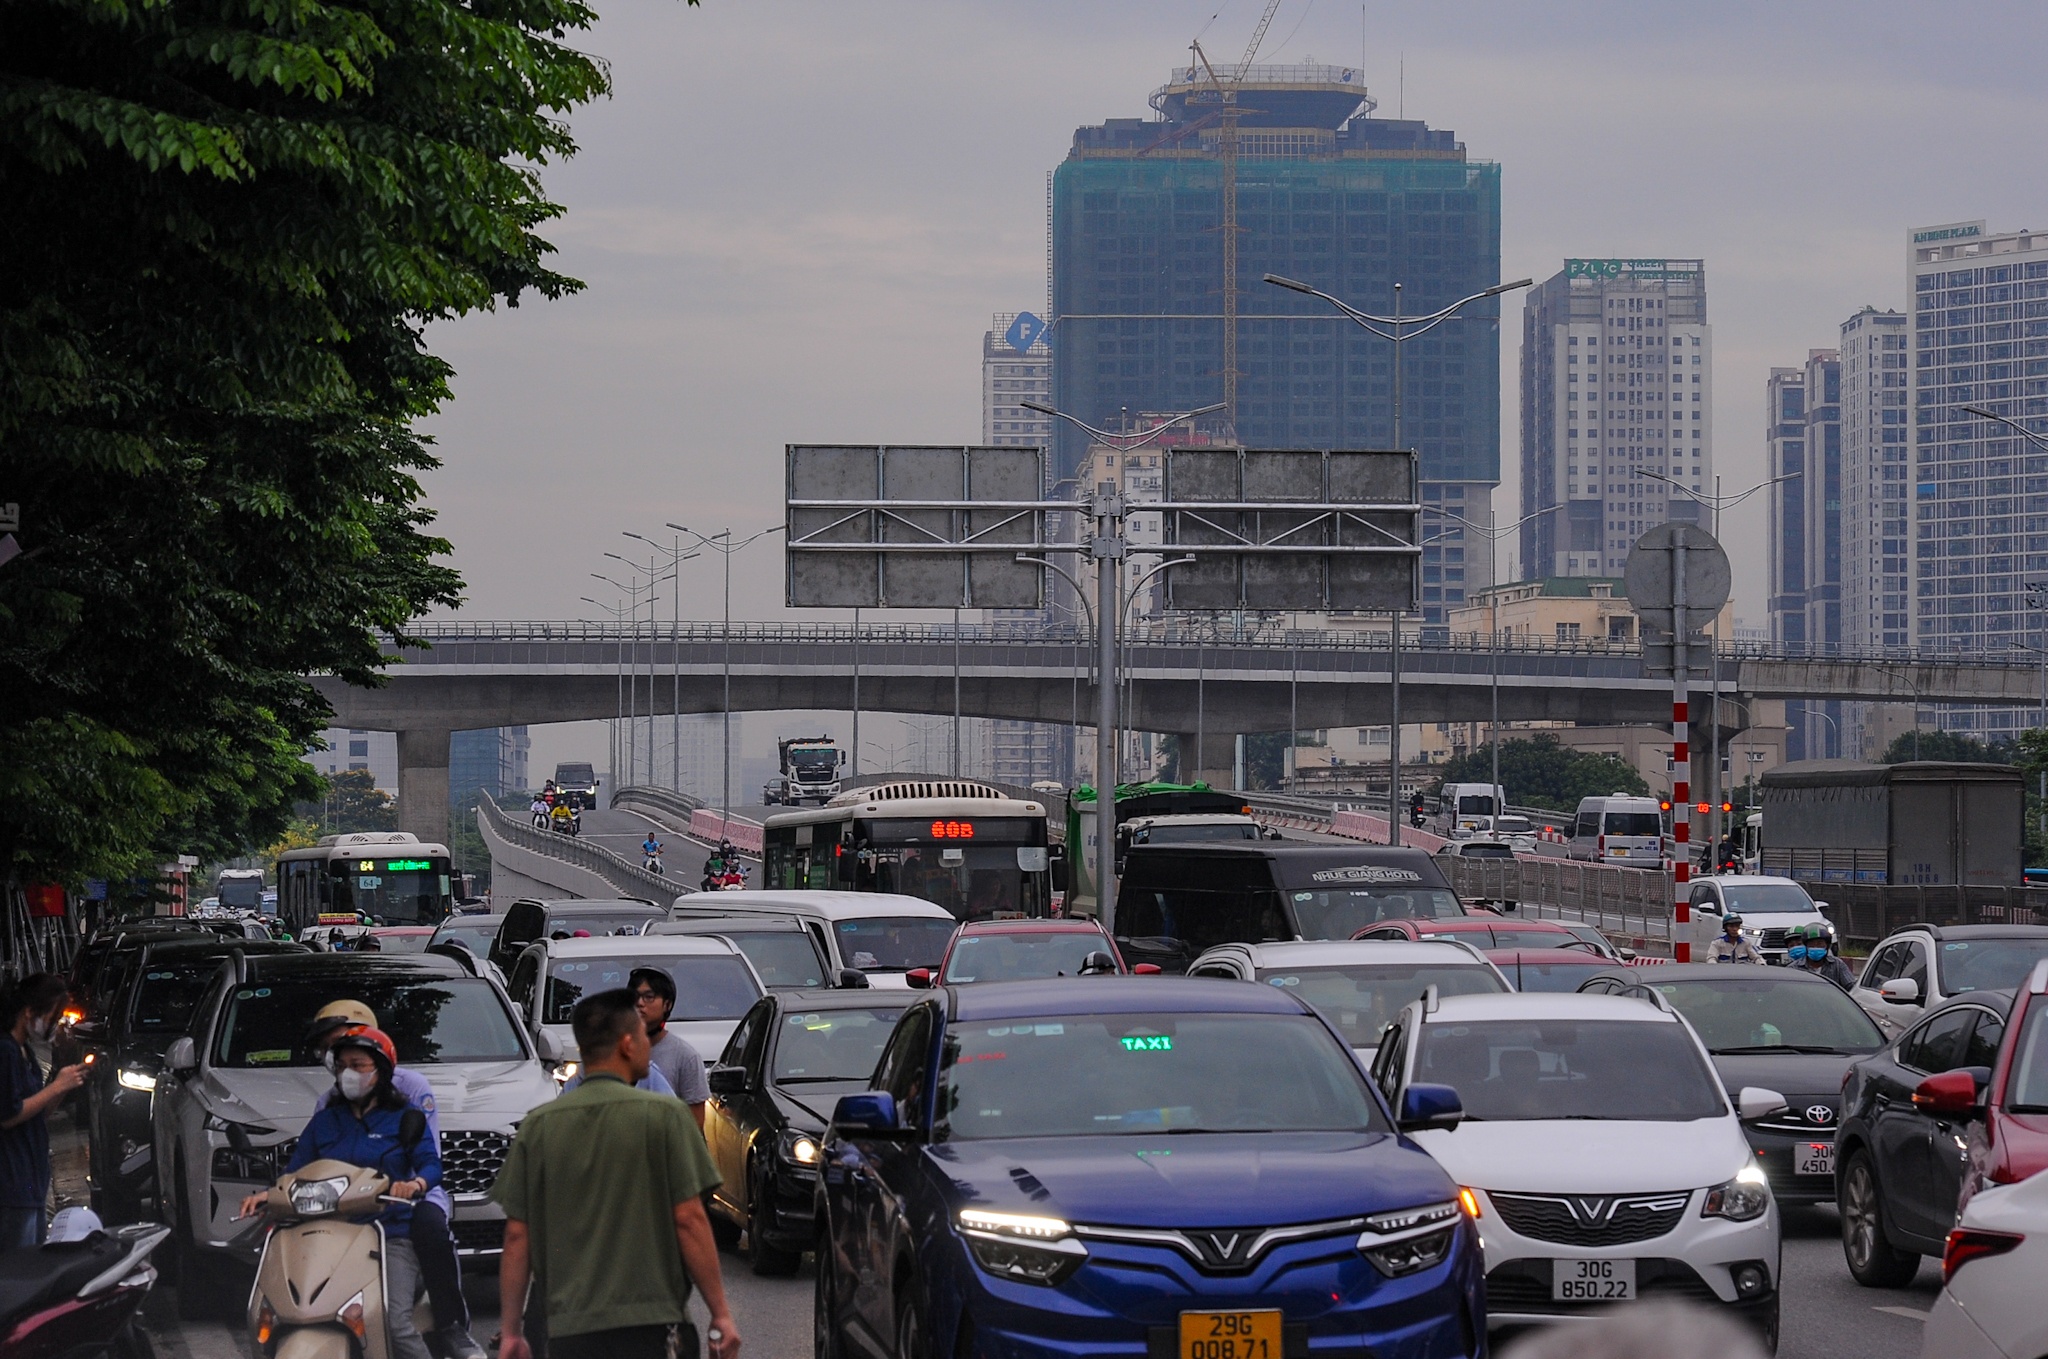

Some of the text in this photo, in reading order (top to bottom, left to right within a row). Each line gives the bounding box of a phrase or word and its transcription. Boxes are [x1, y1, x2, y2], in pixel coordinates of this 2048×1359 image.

[1020, 323, 1031, 340] F
[360, 861, 374, 871] 64
[1913, 863, 1931, 873] 18H
[363, 879, 374, 888] 64
[1312, 870, 1422, 881] NHUE GIANG HOTEL
[1121, 1036, 1172, 1051] TAXI
[1577, 1261, 1612, 1278] 30G
[1562, 1281, 1627, 1298] 850.22
[1209, 1315, 1252, 1336] 29G
[1191, 1338, 1269, 1359] 008.71
